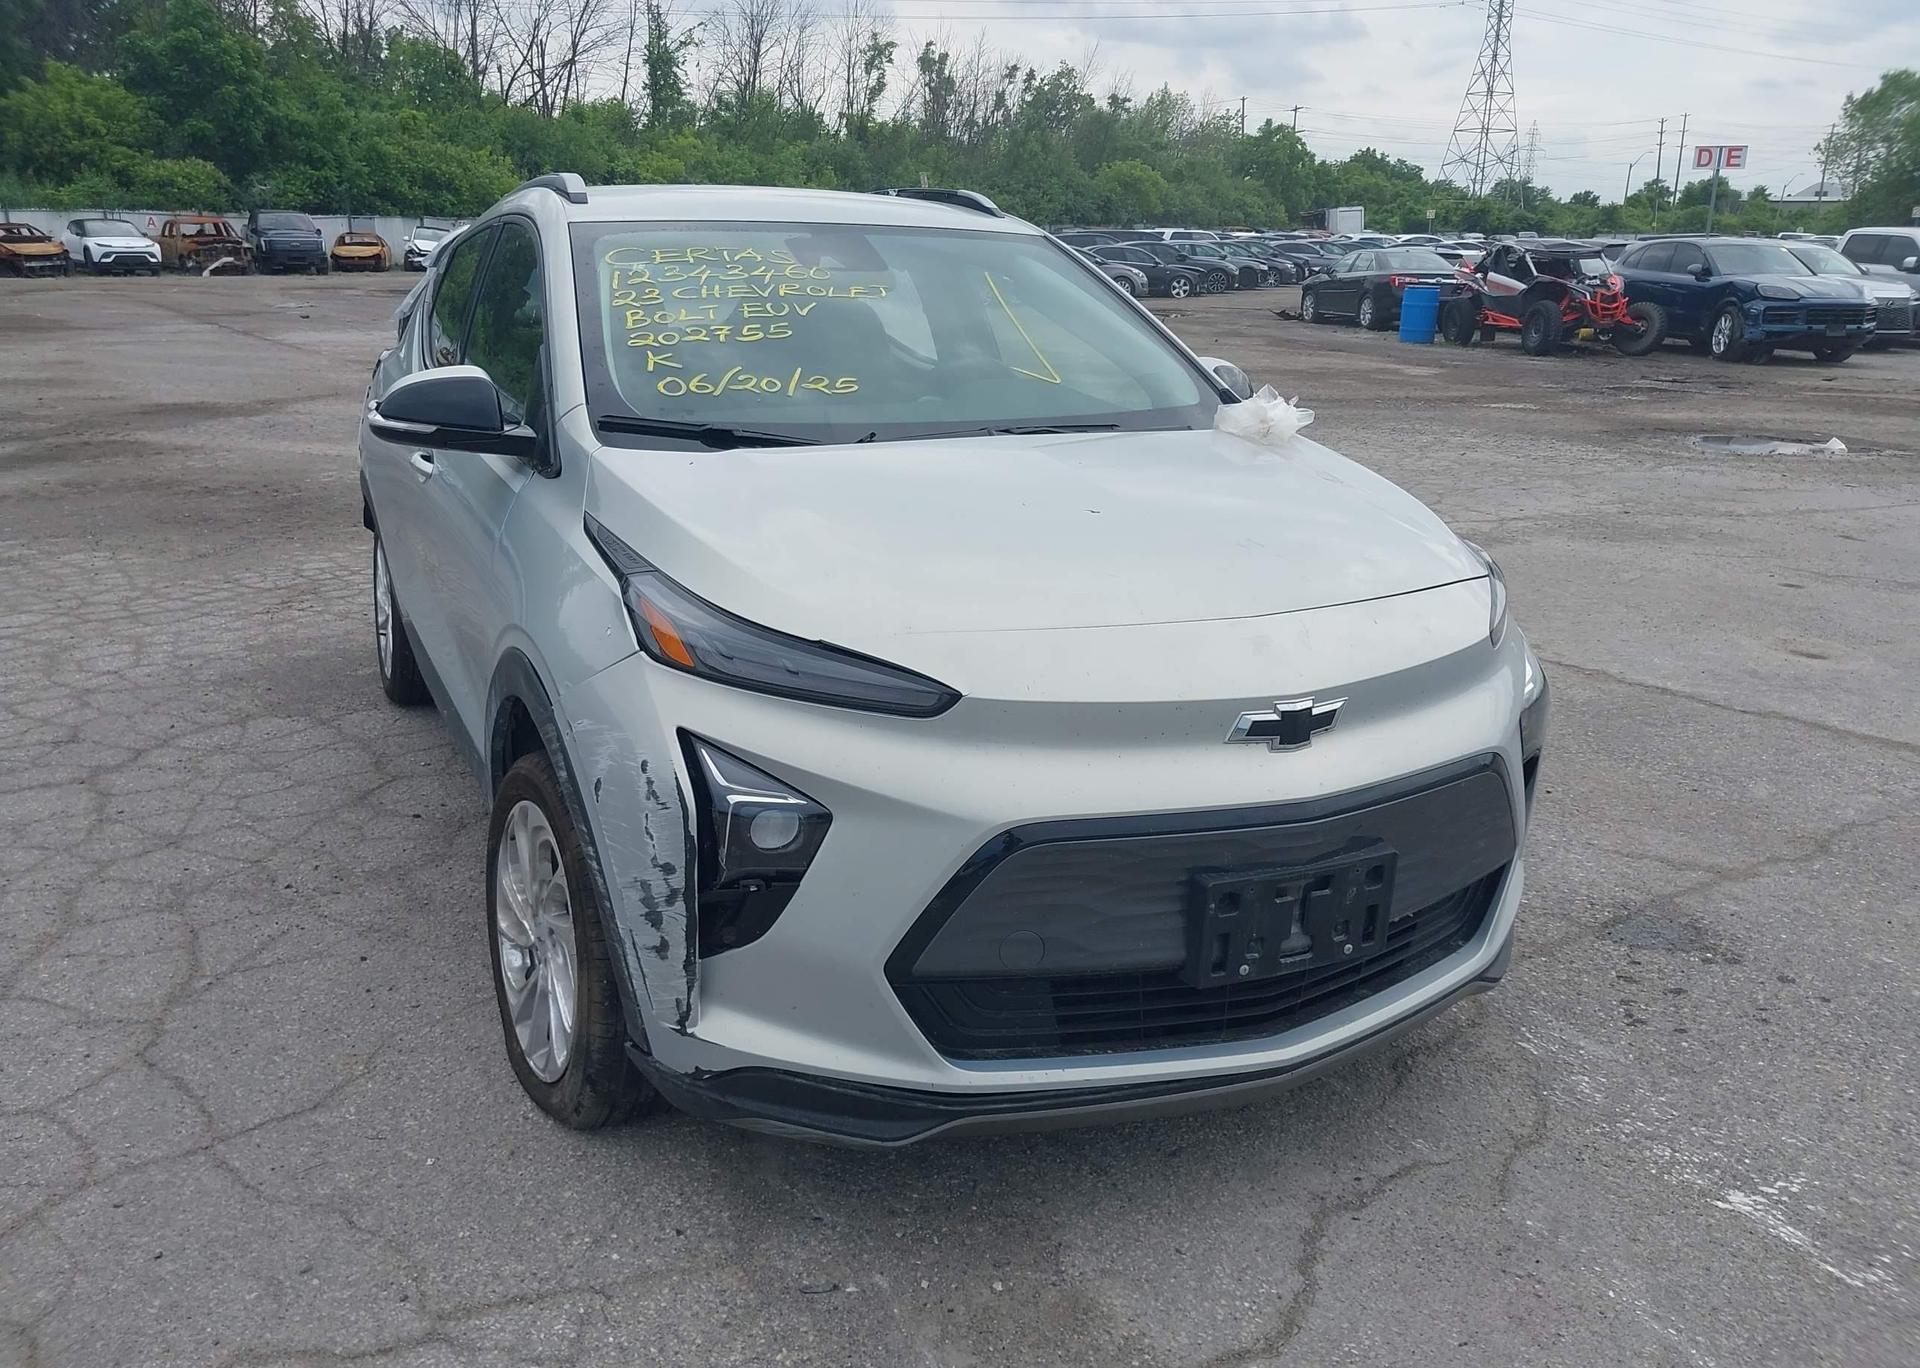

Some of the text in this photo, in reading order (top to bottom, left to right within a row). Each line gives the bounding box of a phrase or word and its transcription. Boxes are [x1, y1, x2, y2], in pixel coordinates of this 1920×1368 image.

[1696, 149, 1713, 168] D
[1725, 148, 1743, 167] E
[147, 216, 157, 228] A
[604, 247, 796, 265] CERTAS
[612, 264, 831, 289] 12343460
[612, 283, 888, 307] 23 CHEVROLET
[625, 302, 817, 329] BOLT EUV
[627, 322, 793, 347] 202755
[647, 350, 683, 372] K
[656, 366, 859, 397] 06/20/25
